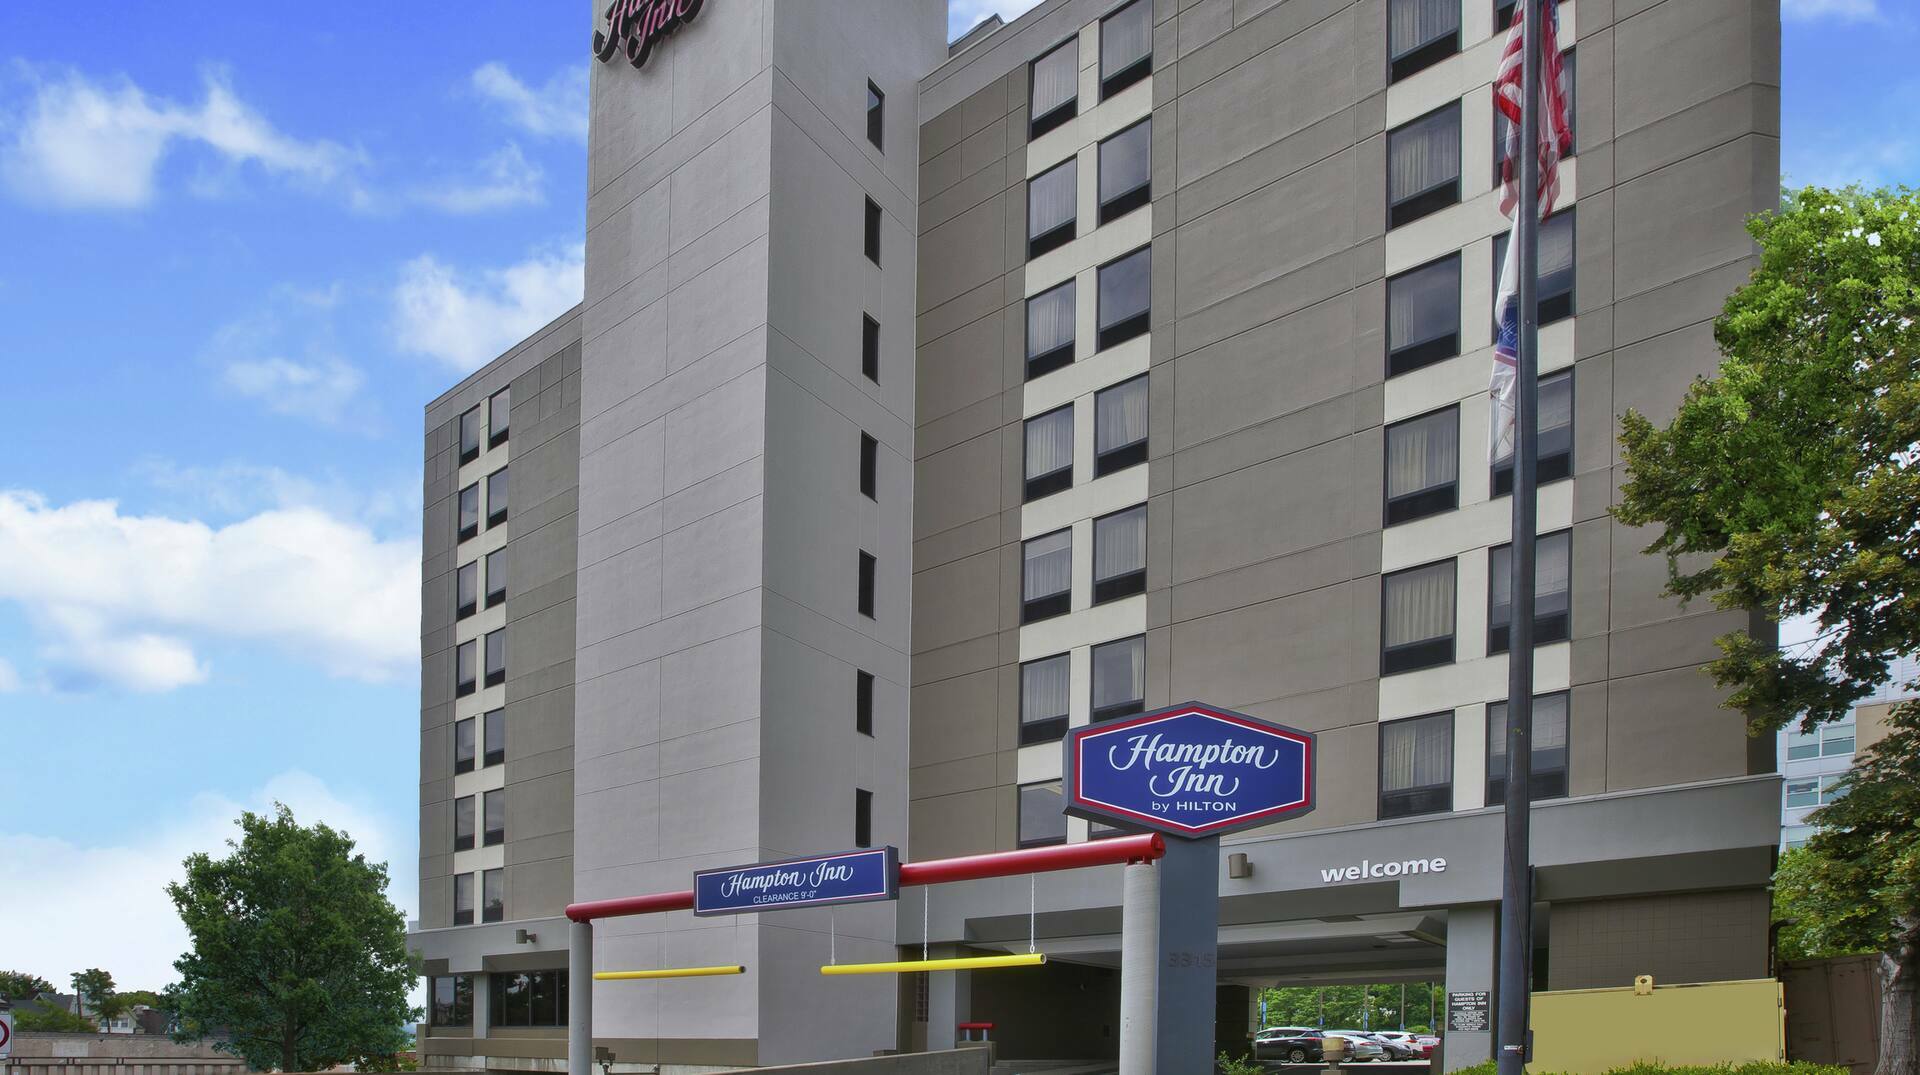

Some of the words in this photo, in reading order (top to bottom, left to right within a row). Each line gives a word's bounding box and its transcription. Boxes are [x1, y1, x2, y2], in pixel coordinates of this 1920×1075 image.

[1108, 733, 1279, 771] Hampton
[1149, 765, 1239, 798] Inn
[1152, 801, 1170, 813] by
[1176, 801, 1237, 812] HILTON
[721, 870, 806, 898] Hampton
[809, 862, 854, 888] Inn
[1320, 857, 1447, 883] welcome
[753, 892, 799, 904] CLEARANCE
